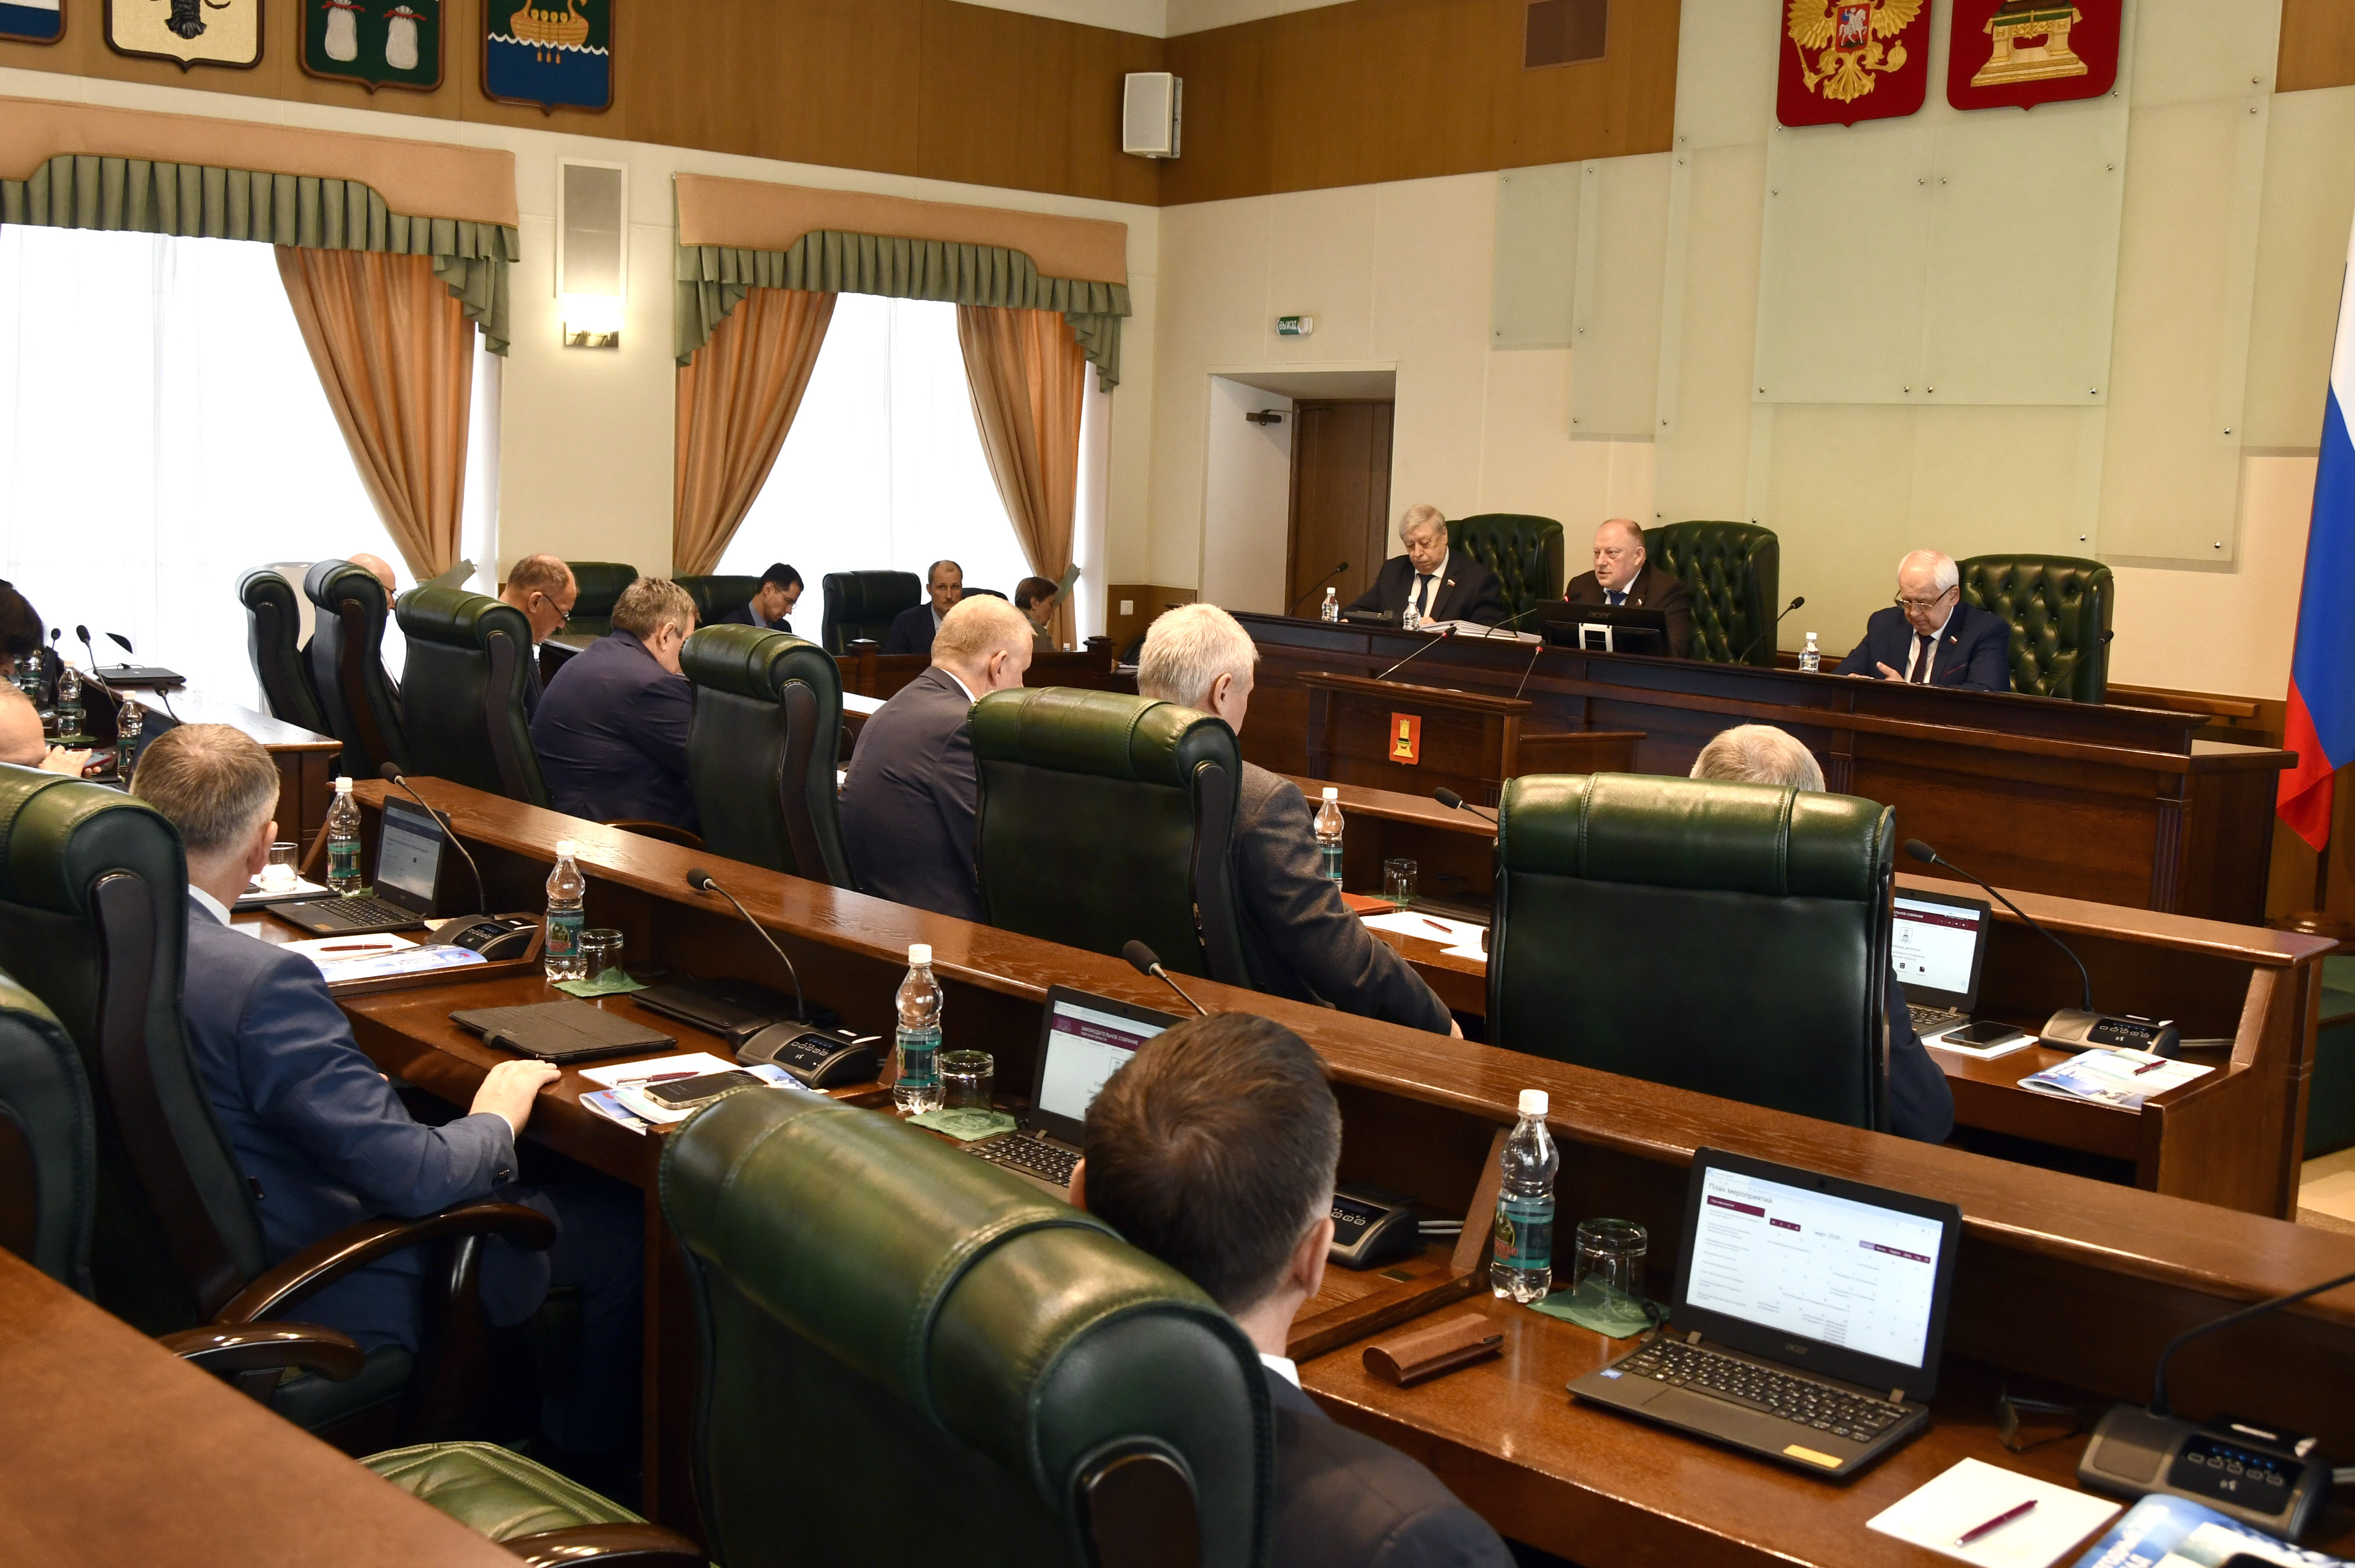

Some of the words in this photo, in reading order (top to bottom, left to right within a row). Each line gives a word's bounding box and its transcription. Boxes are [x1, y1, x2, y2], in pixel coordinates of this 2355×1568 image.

[1279, 320, 1297, 331] ВЫХОД
[1081, 1026, 1118, 1040] ЗАКОНОДАТЕЛЬНОЕ
[1118, 1035, 1139, 1046] СОБРАНИЕ
[1709, 1183, 1726, 1193] План
[1727, 1188, 1773, 1204] мероприятий
